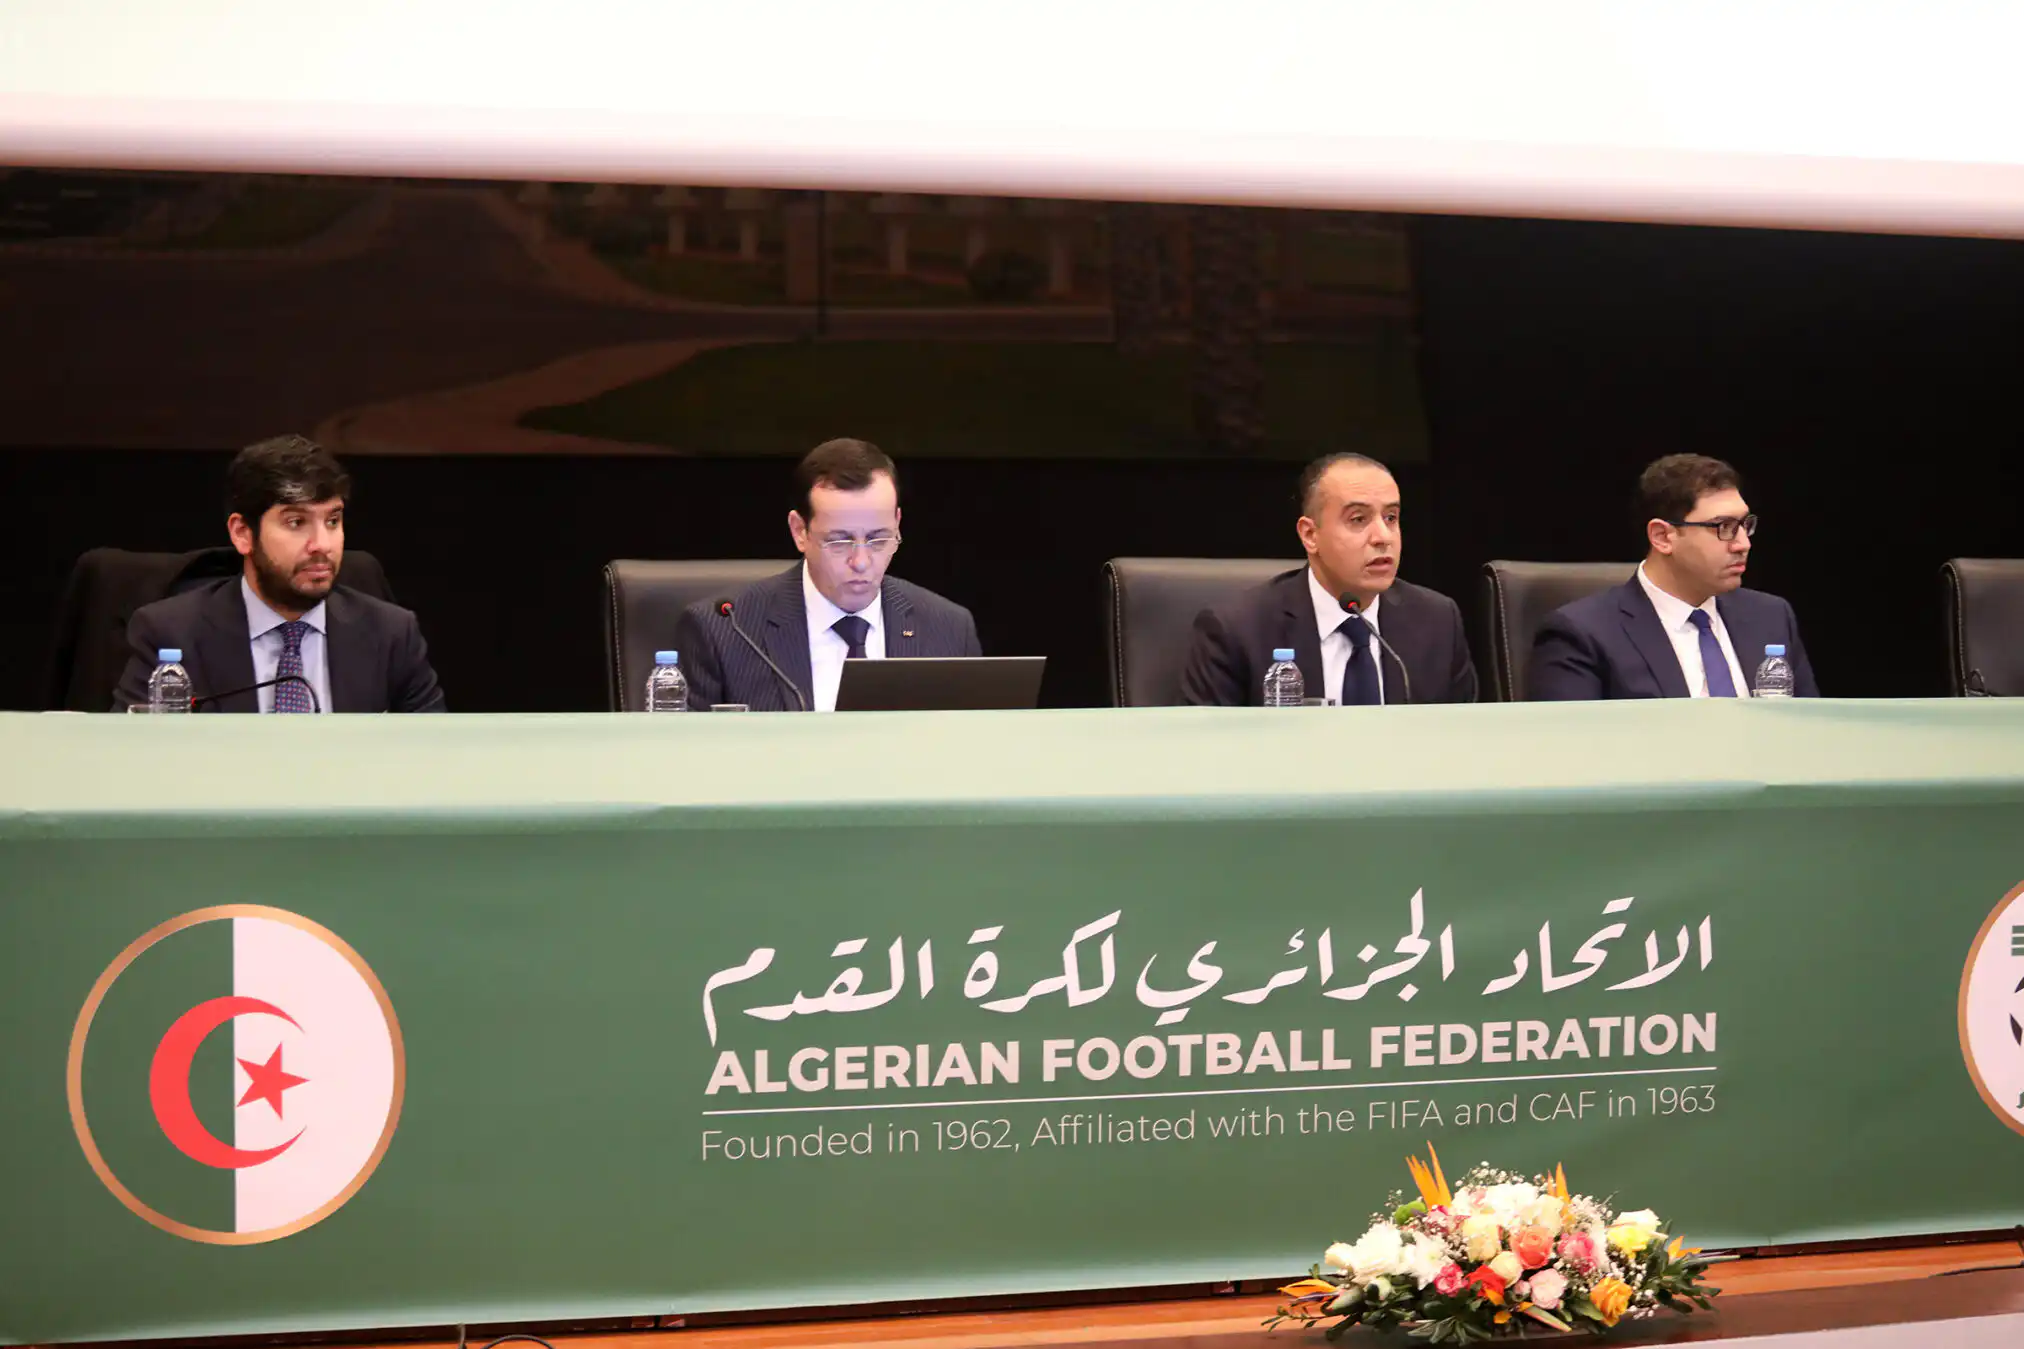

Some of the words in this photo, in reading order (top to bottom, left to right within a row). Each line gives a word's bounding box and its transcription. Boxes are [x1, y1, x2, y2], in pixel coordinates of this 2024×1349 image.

[702, 935, 935, 1046] القدم
[963, 910, 1122, 1013] لكرة
[1135, 887, 1456, 1027] الجزائري
[1482, 896, 1714, 995] الاتحاد
[704, 1040, 1020, 1095] ALGERIAN
[1042, 1028, 1352, 1080] FOOTBALL
[1369, 1012, 1717, 1068] FEDERATION
[702, 1123, 874, 1160] Founded
[886, 1122, 919, 1156] in
[932, 1118, 1021, 1153] 1962,
[1031, 1109, 1197, 1147] Affiliated
[1208, 1104, 1285, 1138] with
[1296, 1100, 1355, 1134] the
[1368, 1099, 1444, 1130] FIFA
[1455, 1094, 1518, 1127] and
[1528, 1090, 1597, 1121] CAF
[1607, 1088, 1636, 1117] in
[1646, 1085, 1717, 1116] 1963
